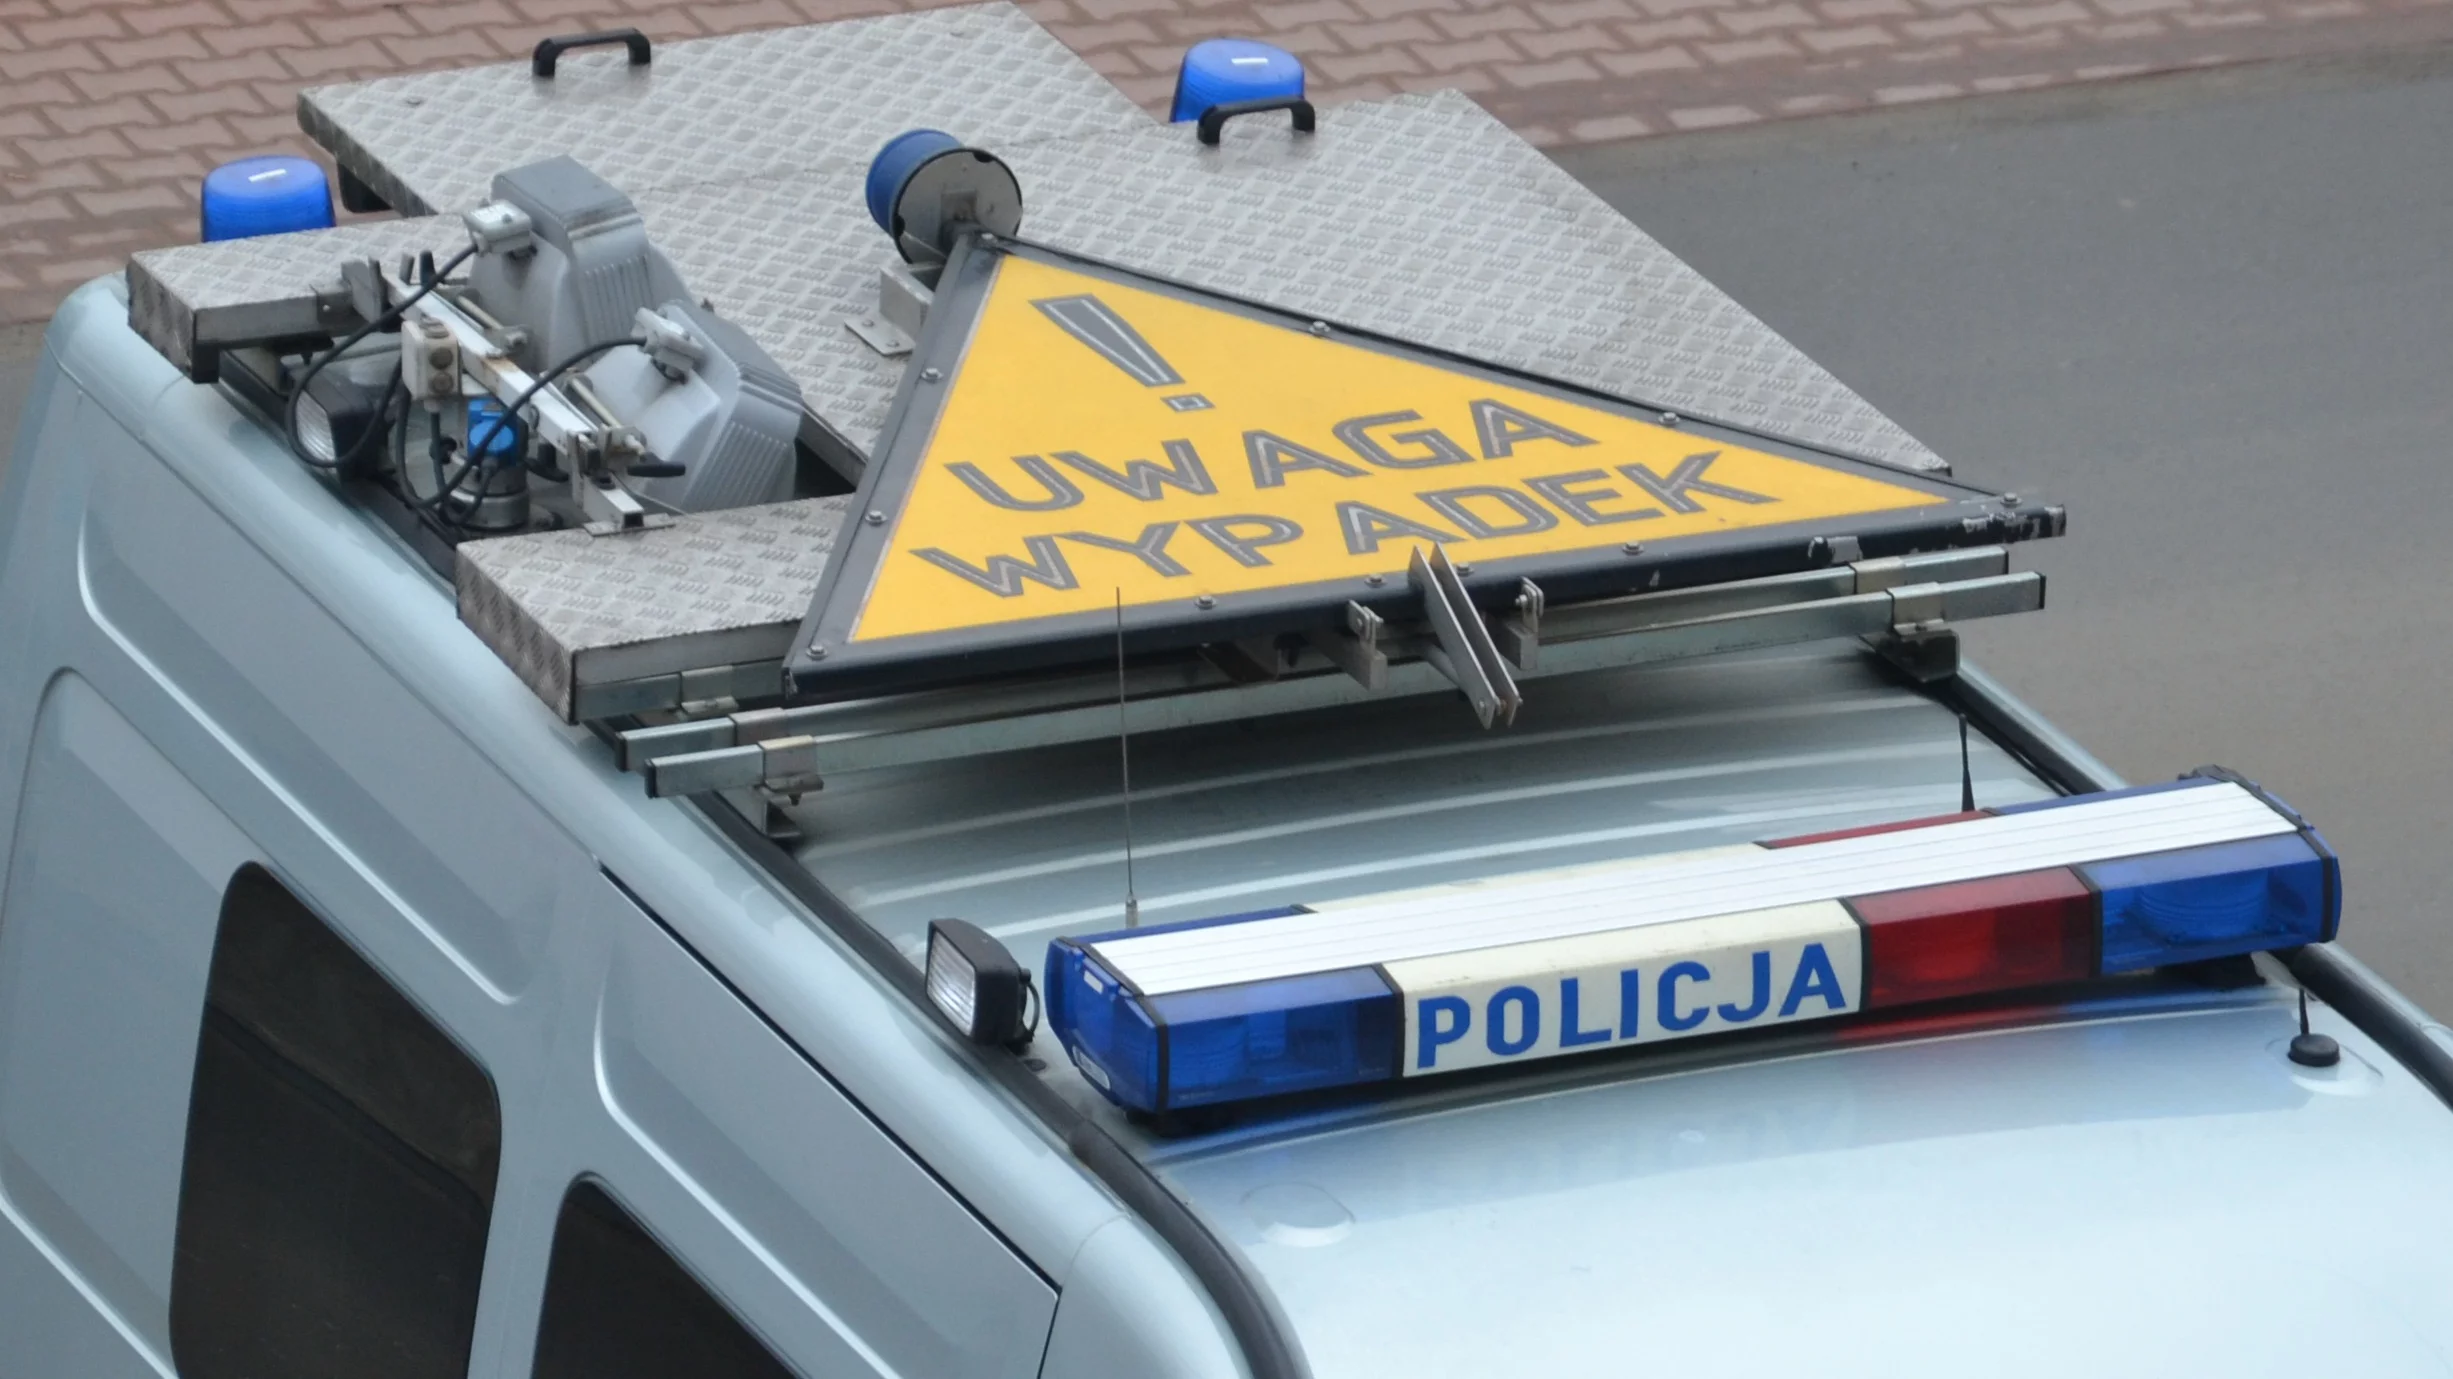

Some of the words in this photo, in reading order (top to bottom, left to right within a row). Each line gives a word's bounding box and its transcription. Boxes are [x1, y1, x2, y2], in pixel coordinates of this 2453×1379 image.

[945, 400, 1600, 512] UWAGA
[911, 451, 1782, 598] WYPADEK
[1417, 942, 1847, 1068] POLICJA
